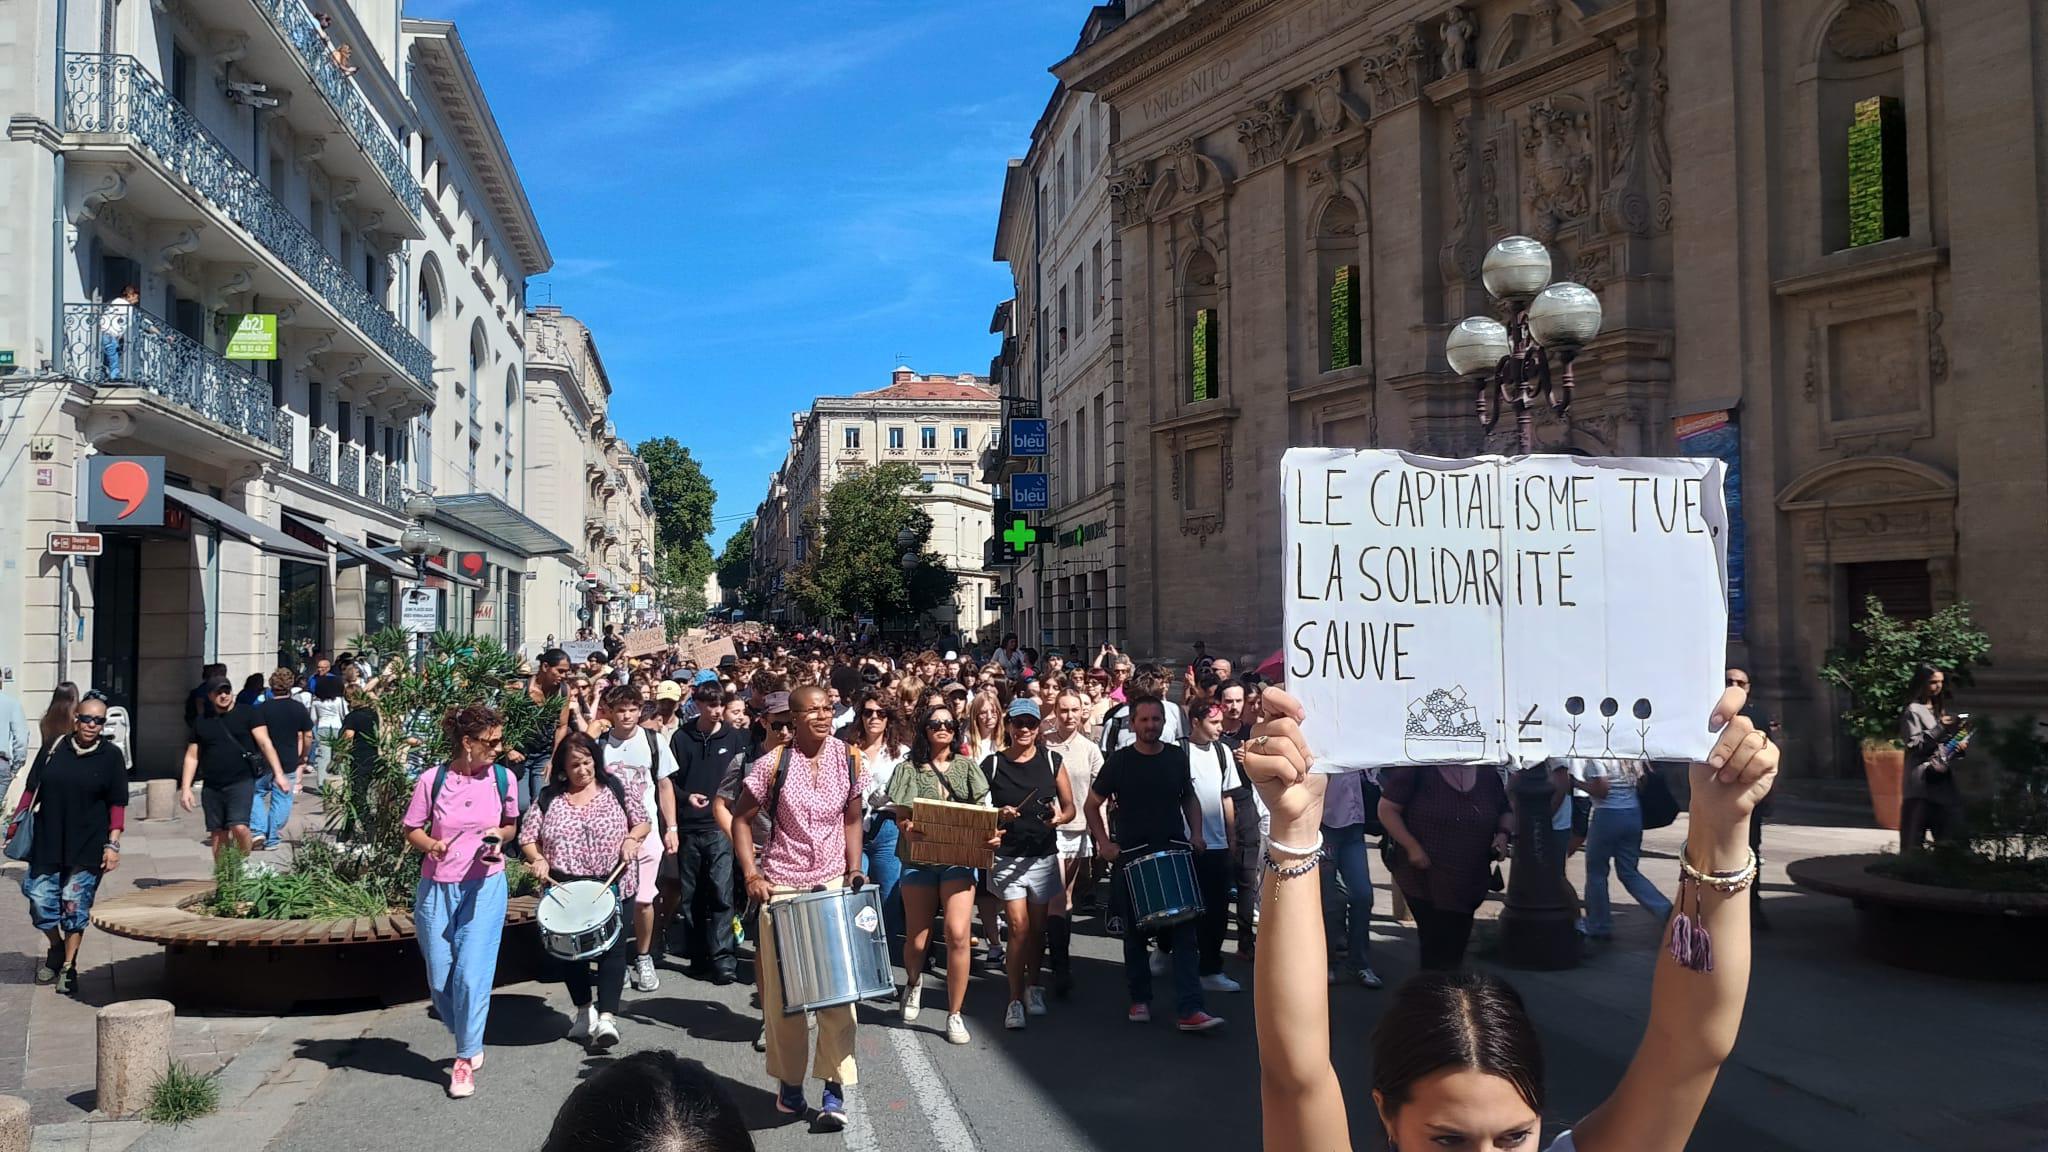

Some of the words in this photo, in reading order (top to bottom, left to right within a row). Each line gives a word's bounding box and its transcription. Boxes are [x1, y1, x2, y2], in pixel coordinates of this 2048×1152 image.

[1014, 434, 1045, 448] bleu
[1015, 489, 1046, 502] bleu
[1298, 469, 1352, 526] LE
[1297, 543, 1343, 601] LA
[1291, 620, 1415, 681] SAUVE
